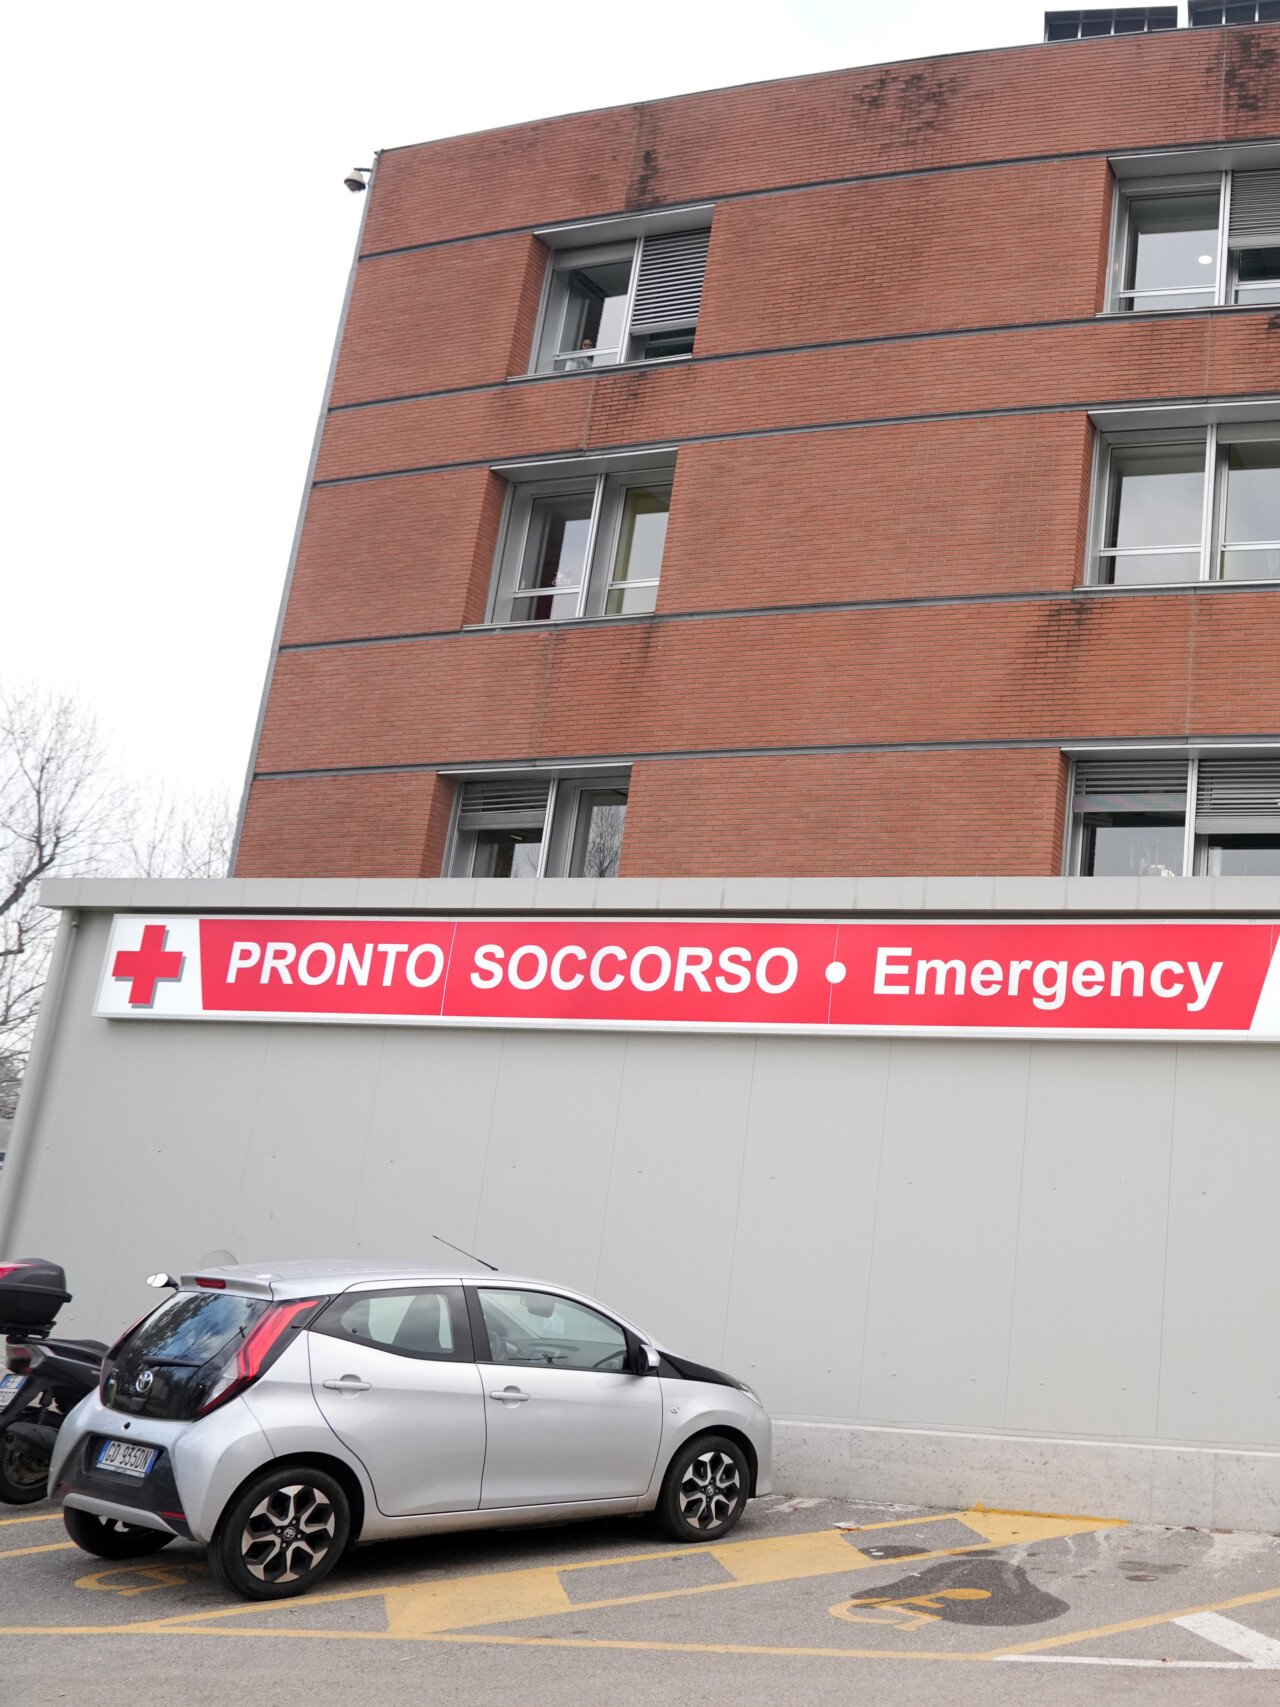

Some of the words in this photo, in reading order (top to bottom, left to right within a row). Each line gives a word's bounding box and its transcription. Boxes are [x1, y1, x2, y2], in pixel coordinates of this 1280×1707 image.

[226, 941, 445, 988] PRONTO
[469, 943, 799, 995] SOCCORSO
[873, 946, 1224, 1012] Emergency
[105, 1443, 121, 1462] GD
